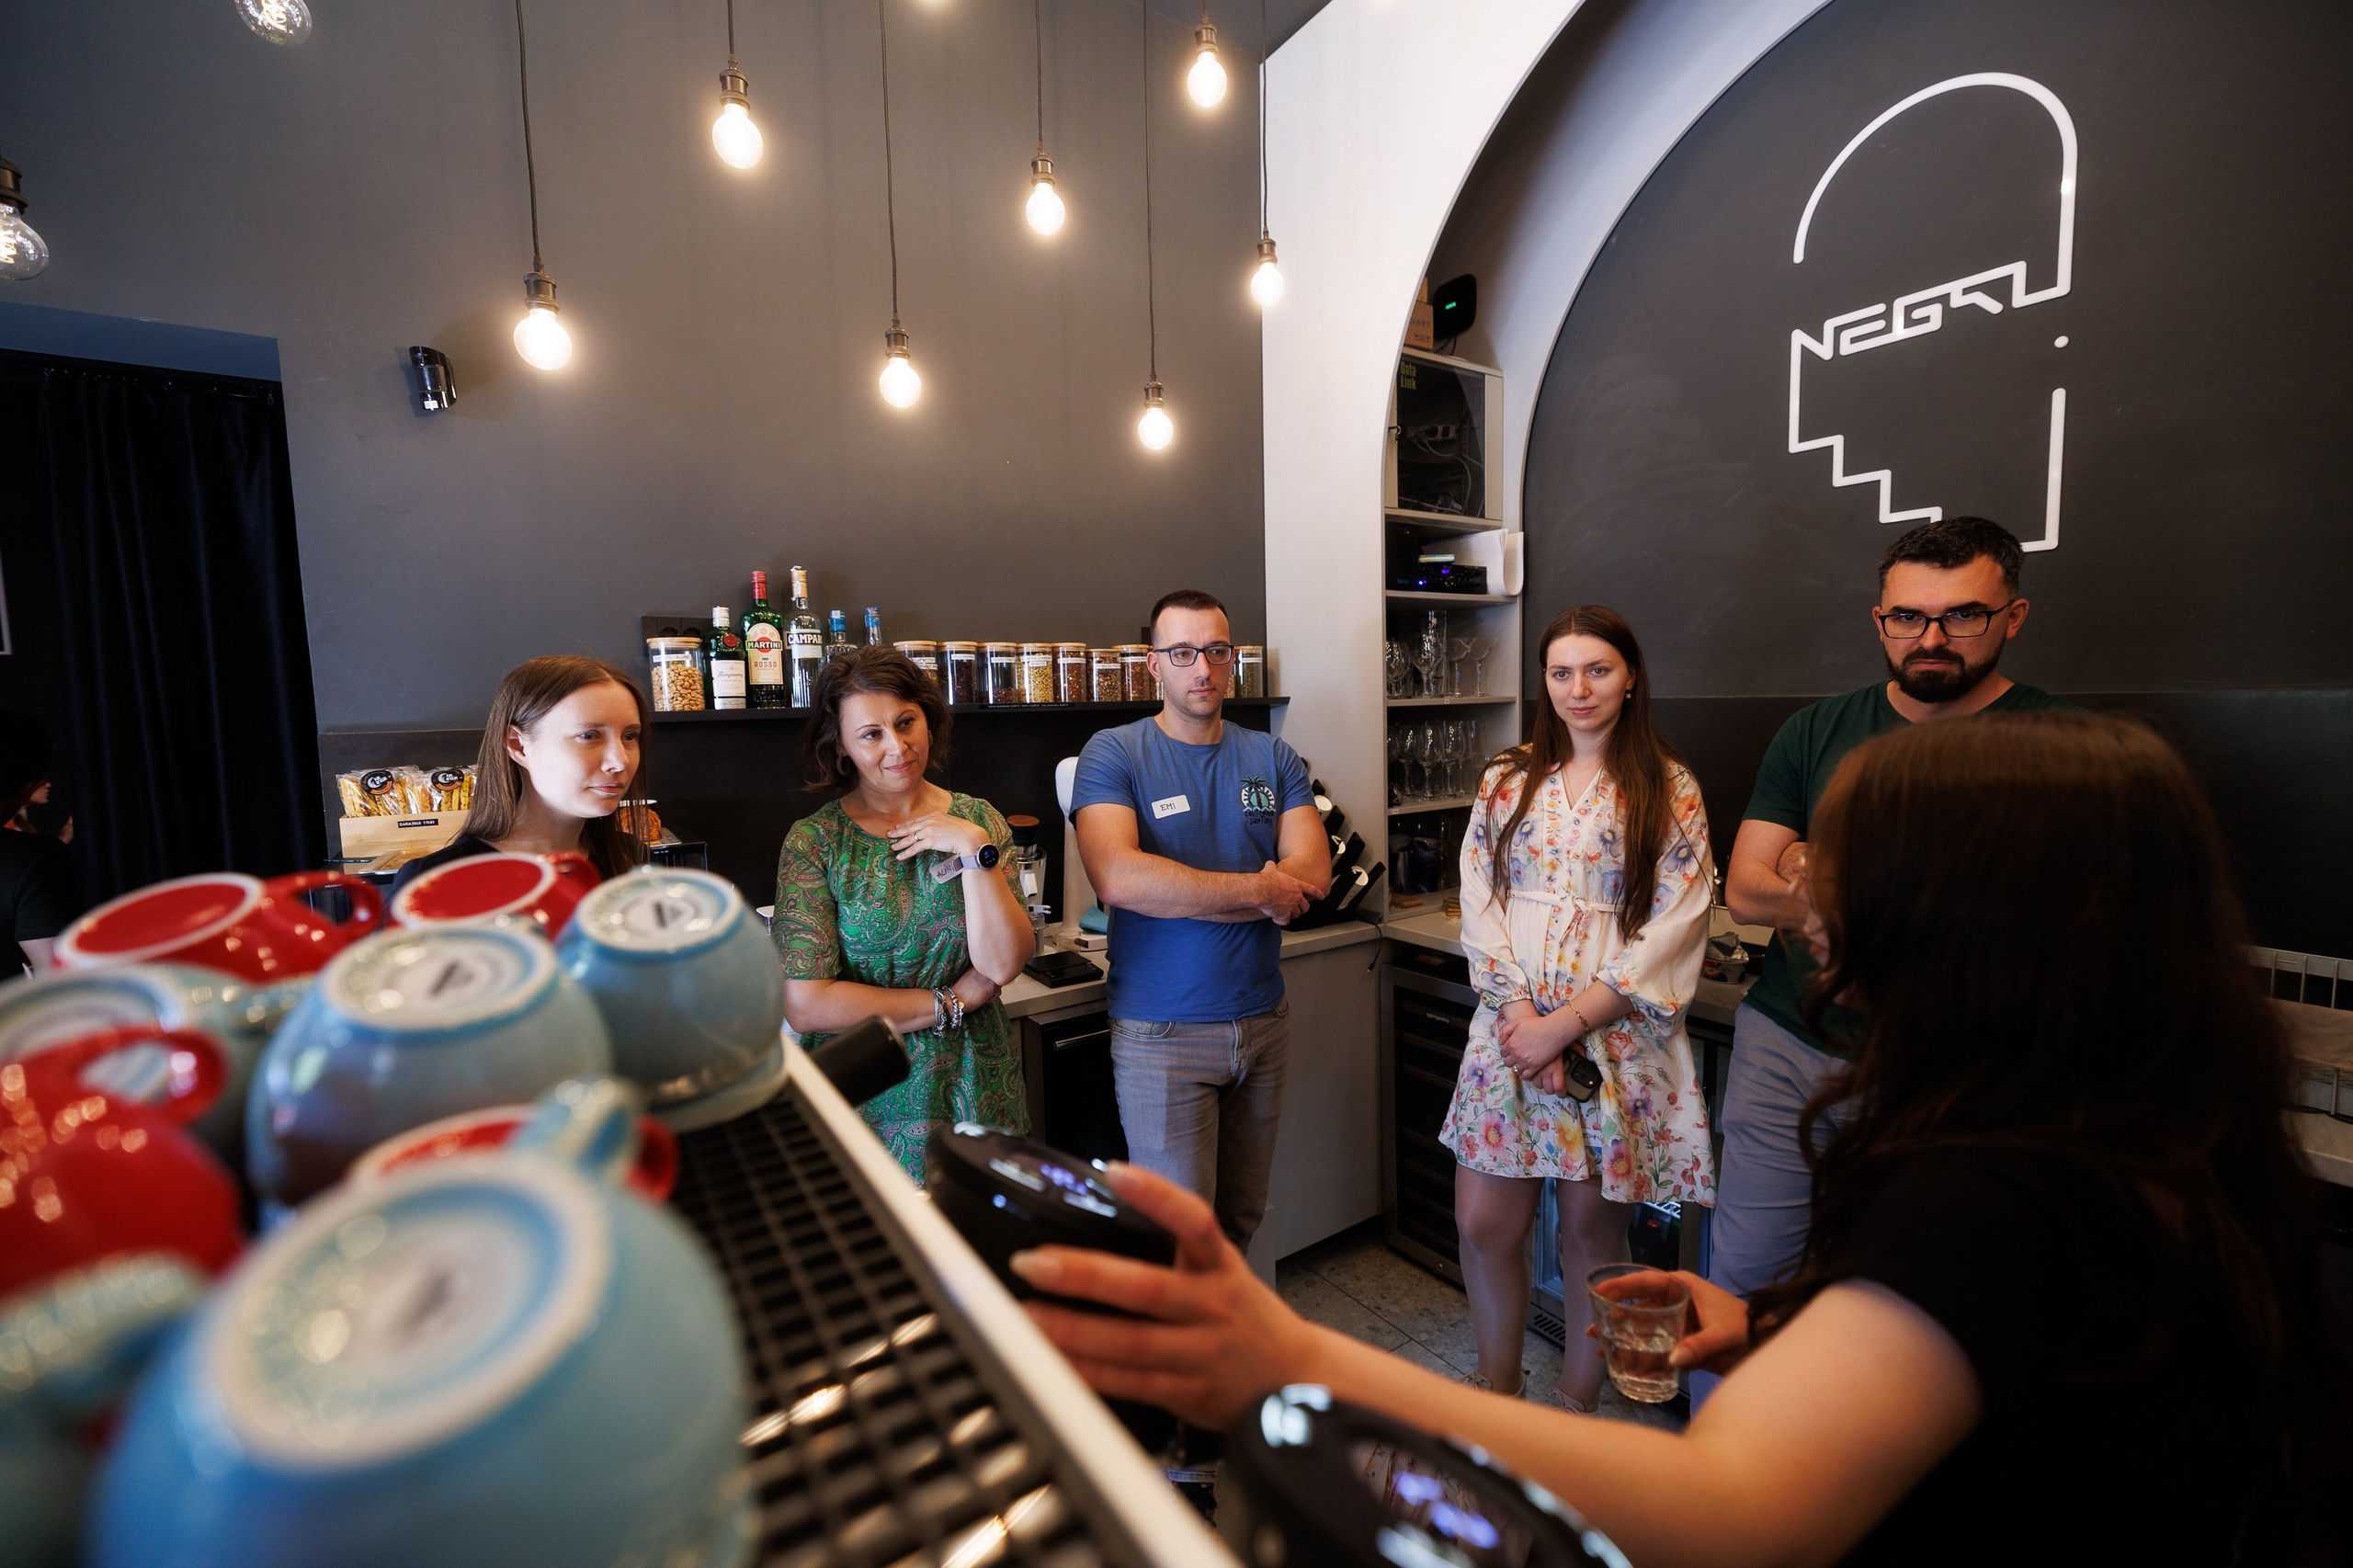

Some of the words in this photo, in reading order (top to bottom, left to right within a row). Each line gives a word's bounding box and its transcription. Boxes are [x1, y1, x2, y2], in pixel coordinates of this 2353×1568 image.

[1790, 260, 2073, 360] NEGRU
[1400, 360, 1416, 377] Data
[1400, 375, 1416, 390] Link
